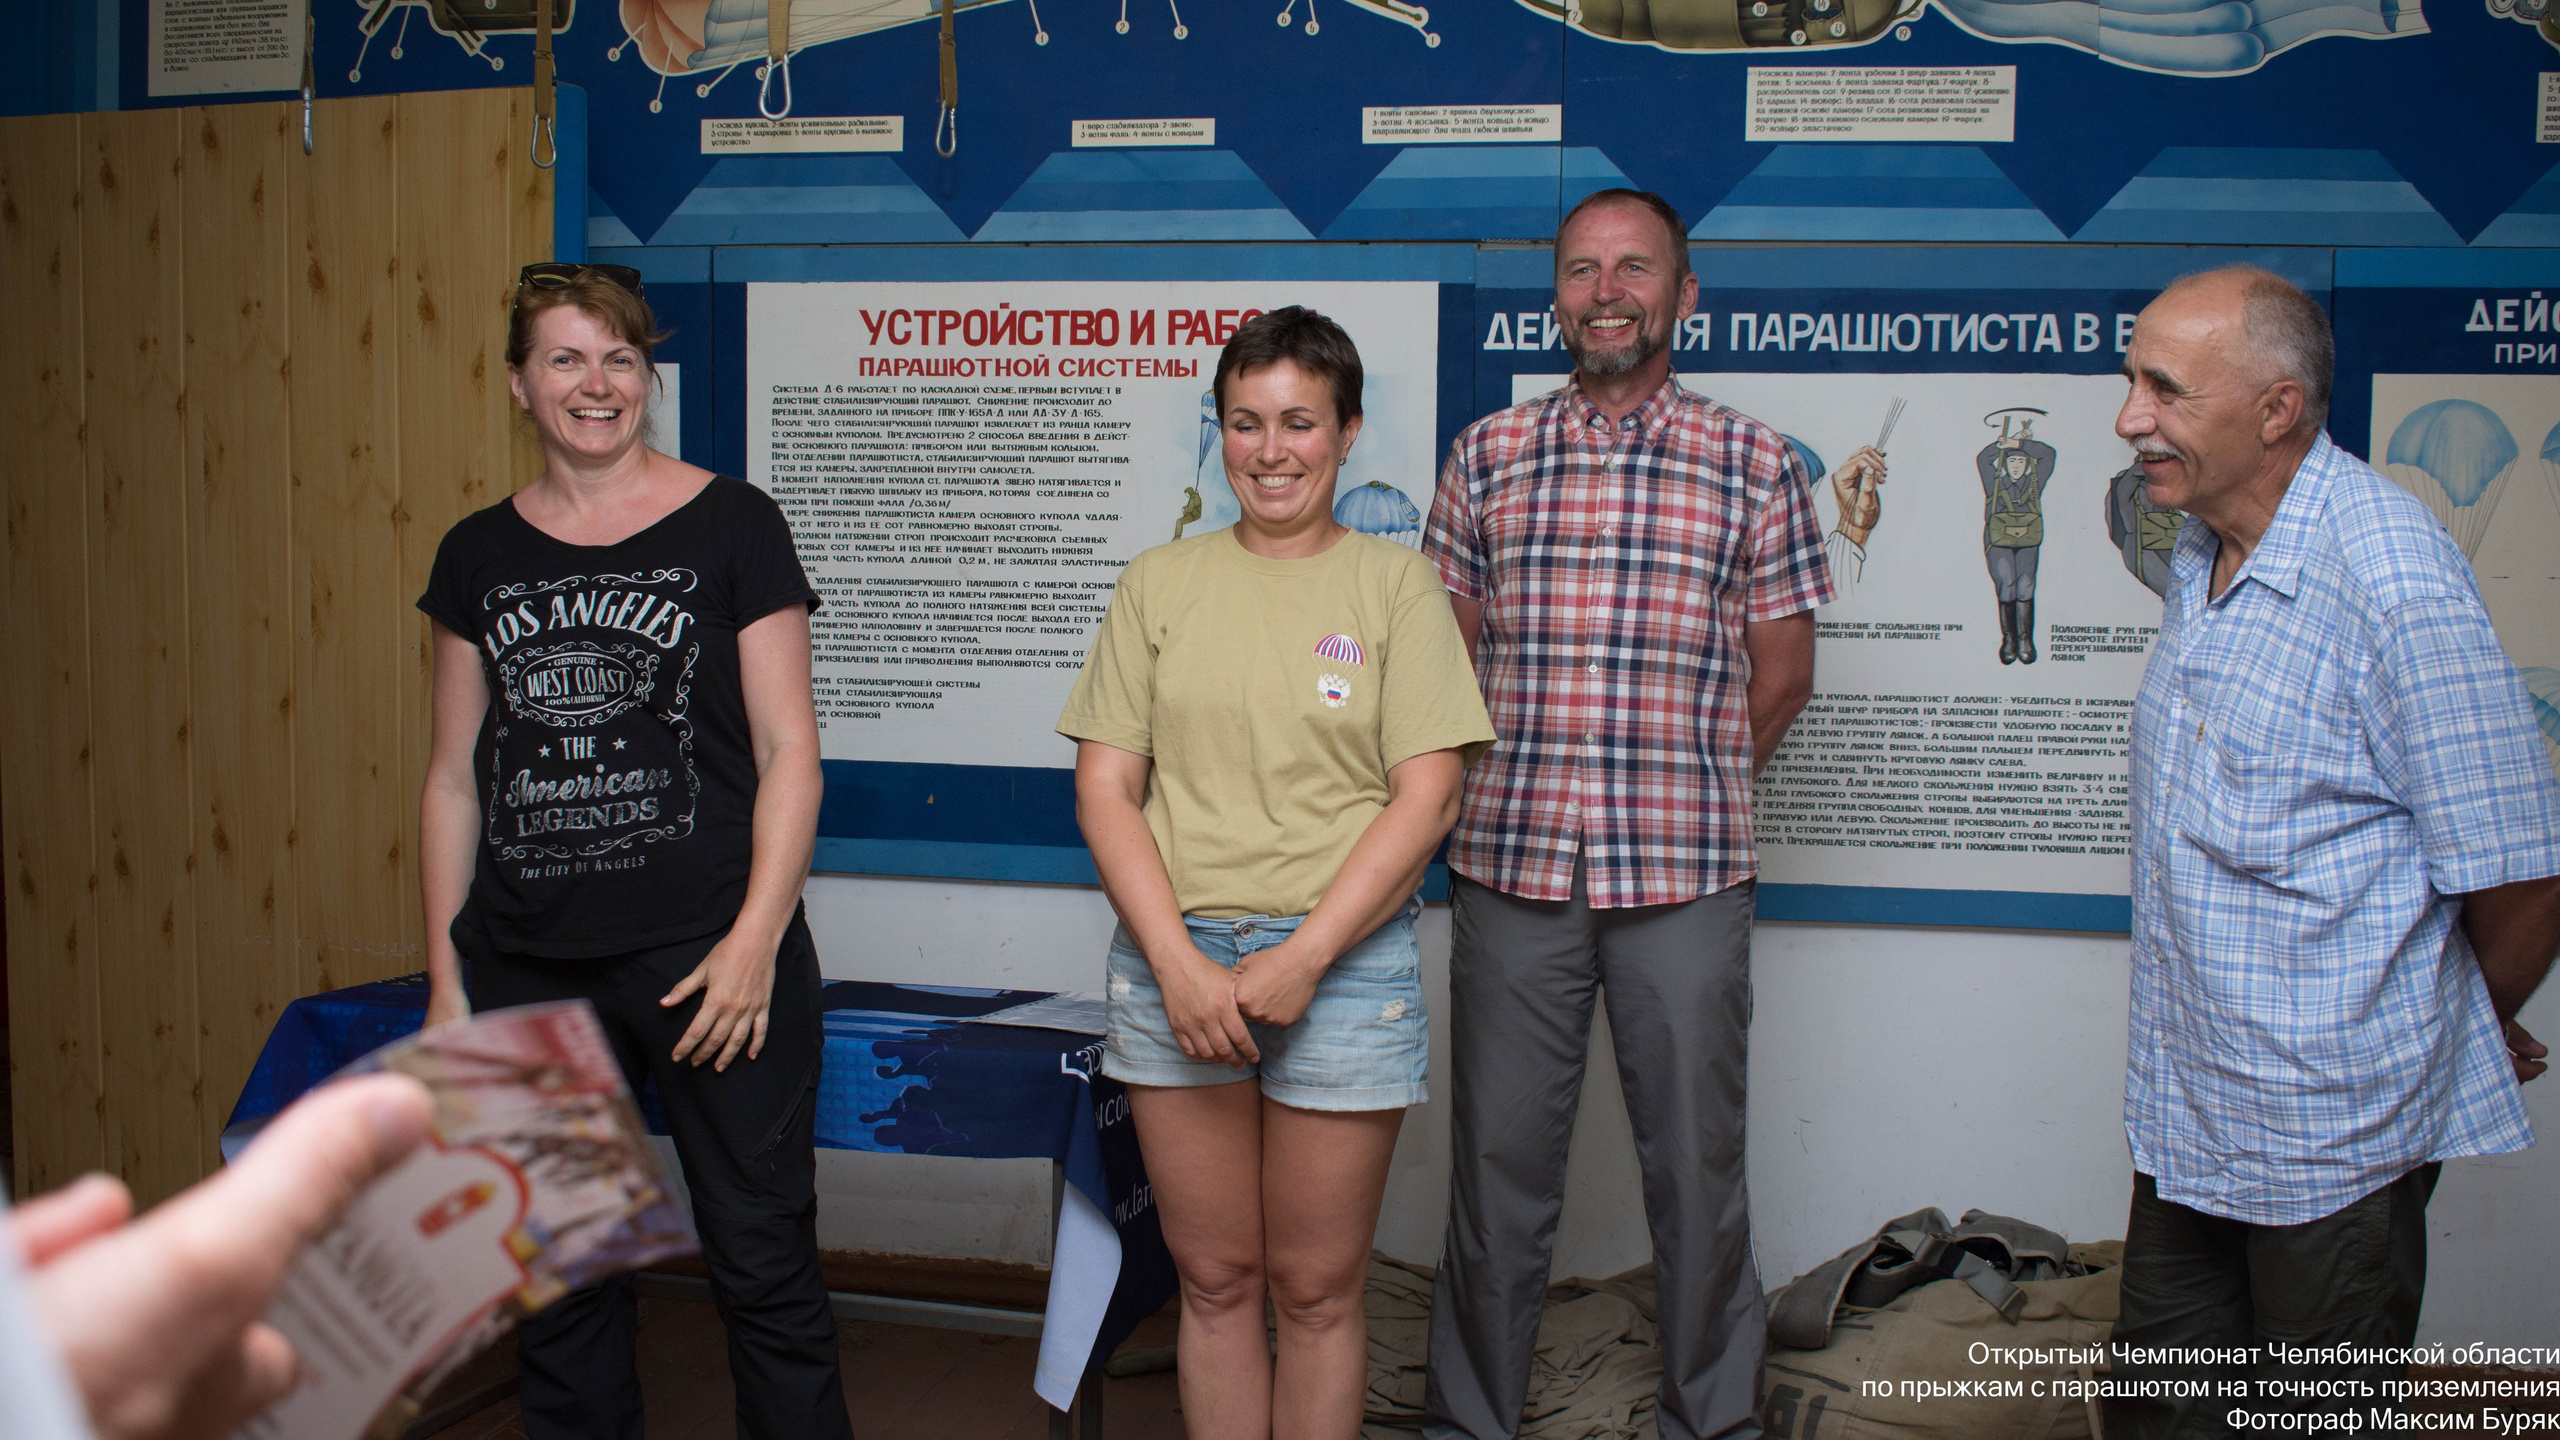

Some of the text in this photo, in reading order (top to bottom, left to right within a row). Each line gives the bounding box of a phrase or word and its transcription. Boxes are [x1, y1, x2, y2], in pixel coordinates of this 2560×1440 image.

[859, 303, 1120, 347] УСТРОЙСТВО
[1130, 310, 1155, 346] И
[1730, 313, 2063, 353] ПАРАШЮТИСТА
[2074, 313, 2101, 353] В
[2494, 343, 2557, 364] ПРИ
[859, 354, 1198, 378] ПАРАШЮТНОЙ СИСТЕМЫ
[772, 385, 818, 393] СИСТЕМА
[968, 431, 975, 439] 2
[1028, 432, 1079, 440] ВВЕДЕНИЯ
[859, 465, 934, 473] ЗАКРЕПЛЕННОЙ
[997, 546, 1048, 554] ВЫХОДИТЬ
[485, 590, 695, 661] LOS ANGELES
[1874, 622, 1940, 630] СКОЛЬЖЕНИЯ
[2050, 624, 2159, 635] ПОЛОЖЕНИЕ РУК ПРИ
[2050, 634, 2148, 643] РАЗВОРОТЕ ПУТЕМ
[554, 657, 597, 667] GENUINE
[2050, 653, 2085, 661] ЛЯМОК
[527, 666, 628, 698] WEST COAST
[1789, 729, 1804, 738] ЗА
[1806, 729, 1843, 737] ЛЕВУЮ
[1846, 730, 1886, 738] ГРУППУ
[1942, 733, 1994, 741] БОЛЬШОЙ
[1997, 734, 2033, 742] ПАЛЕЦ
[2037, 735, 2078, 743] ПРАВОЙ
[2080, 736, 2107, 744] РУКИ
[560, 736, 597, 760] THE
[505, 763, 673, 808] American
[1845, 777, 1868, 787] ДЛЯ
[1872, 780, 1919, 788] МЕЛКОГО
[1923, 781, 1994, 790] СКОЛЬЖЕНИЯ
[1998, 783, 2038, 791] НУЖНО
[2042, 784, 2078, 792] ВЗЯТЬ
[516, 797, 660, 837] LEGENDS
